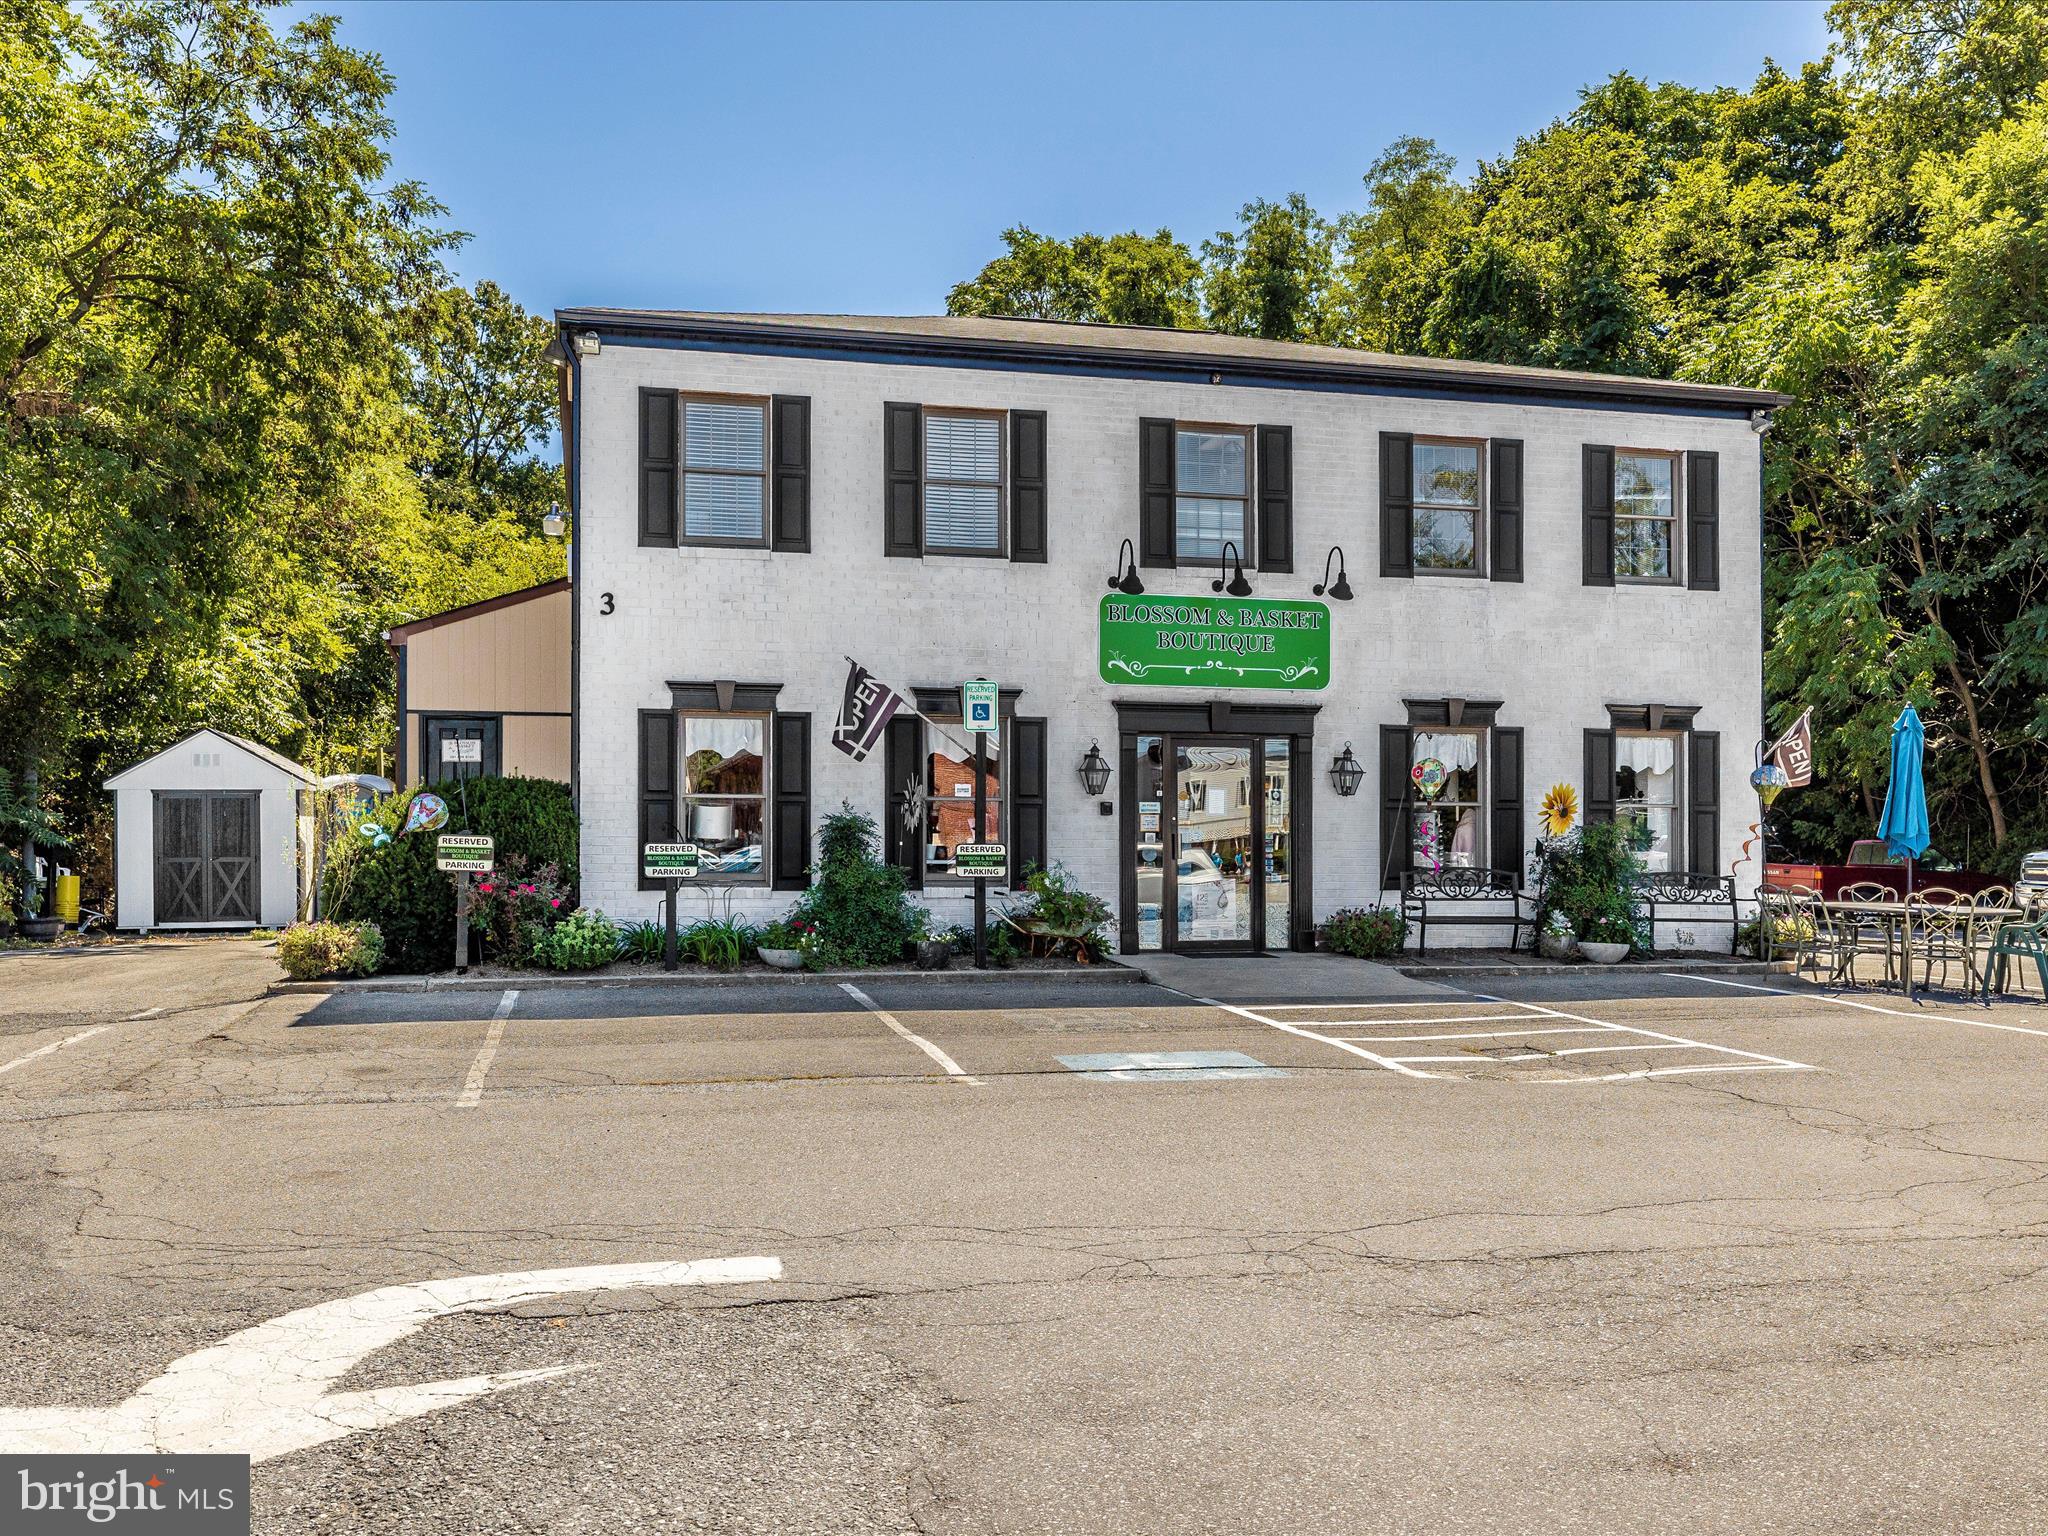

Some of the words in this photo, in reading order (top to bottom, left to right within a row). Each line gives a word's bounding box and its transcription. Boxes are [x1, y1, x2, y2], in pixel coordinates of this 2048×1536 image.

[600, 592, 615, 616] 3
[1106, 603, 1210, 626] BLOSSOM
[1216, 608, 1234, 627] &
[1238, 608, 1323, 629] BASKET
[1156, 630, 1276, 656] BOUTIQUE
[967, 685, 996, 693] RESERVED
[1783, 734, 1812, 775] PEN
[442, 837, 489, 846] RESERVED
[648, 845, 693, 853] RESERVED
[445, 861, 485, 869] PARKING
[652, 868, 690, 876] PARKING
[963, 868, 999, 876] PARKING
